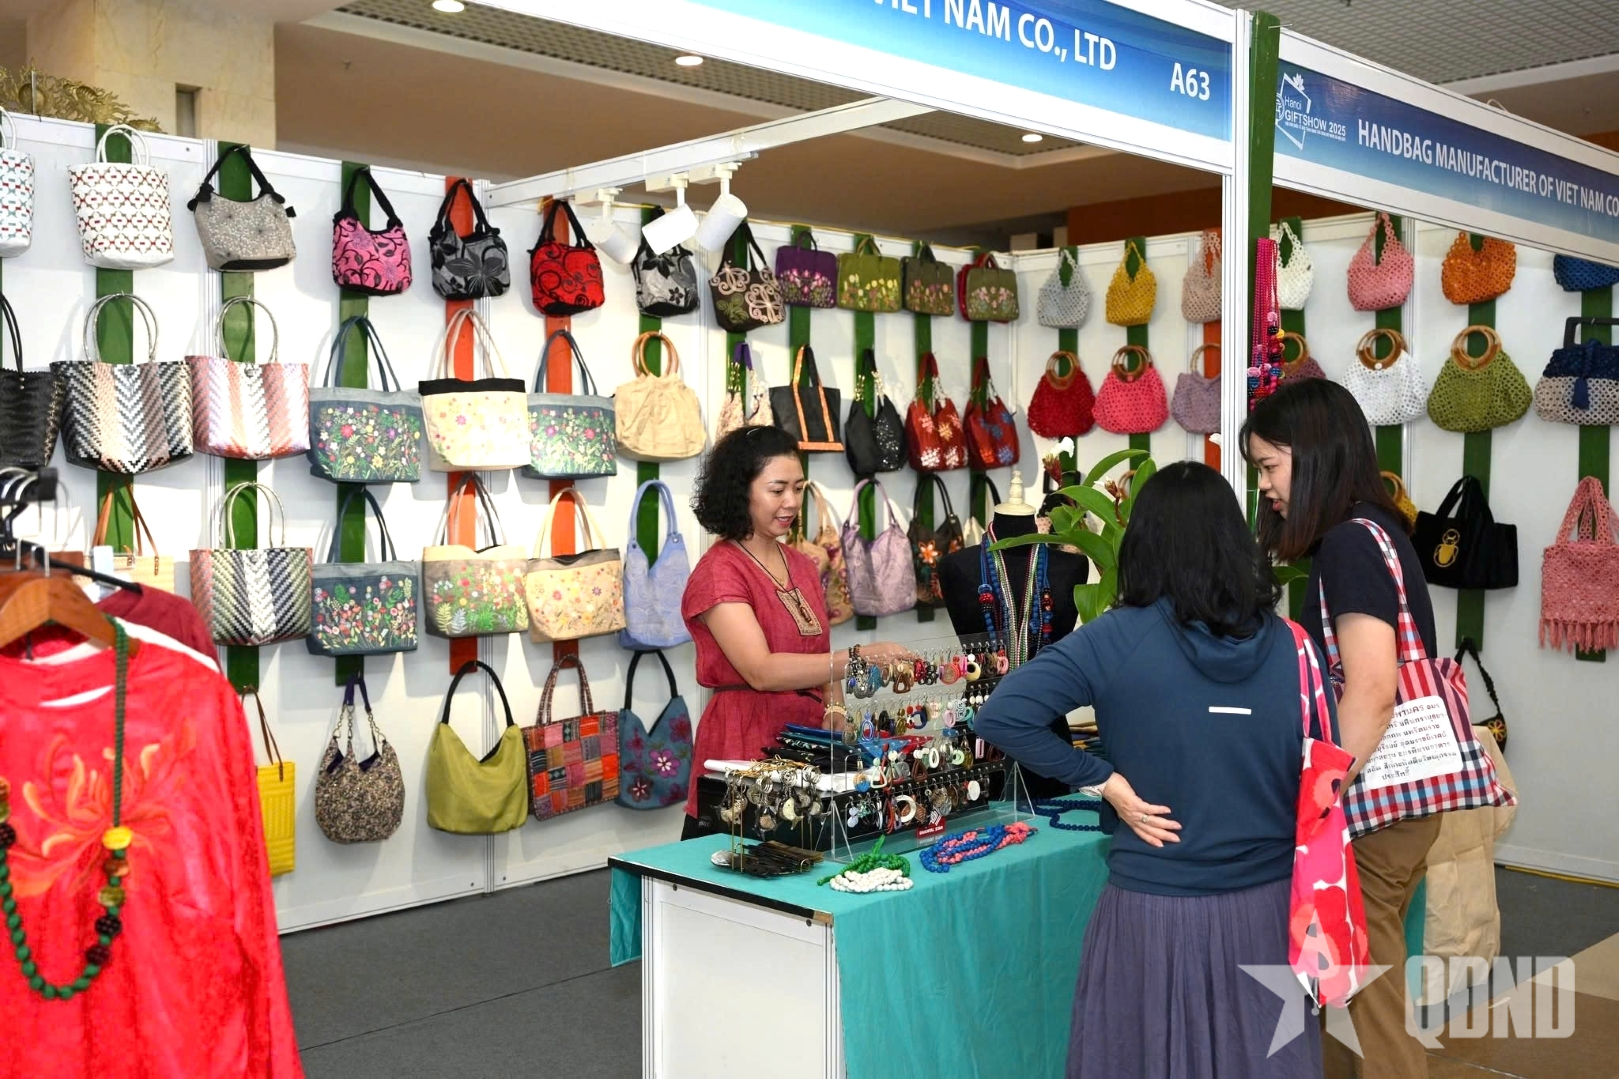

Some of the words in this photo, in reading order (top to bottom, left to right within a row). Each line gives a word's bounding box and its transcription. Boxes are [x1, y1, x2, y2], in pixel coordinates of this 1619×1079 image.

[944, 0, 1010, 42] NAM
[1017, 13, 1068, 63] CO.,
[1074, 29, 1117, 71] LTD
[1170, 63, 1211, 101] A63
[1284, 95, 1302, 111] Hanoi
[1284, 109, 1327, 131] GIFTSHOW
[1328, 121, 1347, 137] 2025
[1358, 119, 1432, 165] HANDBAG
[1435, 143, 1537, 193] MANUFACTURER
[1539, 174, 1554, 198] OF
[1555, 179, 1579, 205] VIET
[1580, 186, 1604, 213] NAM
